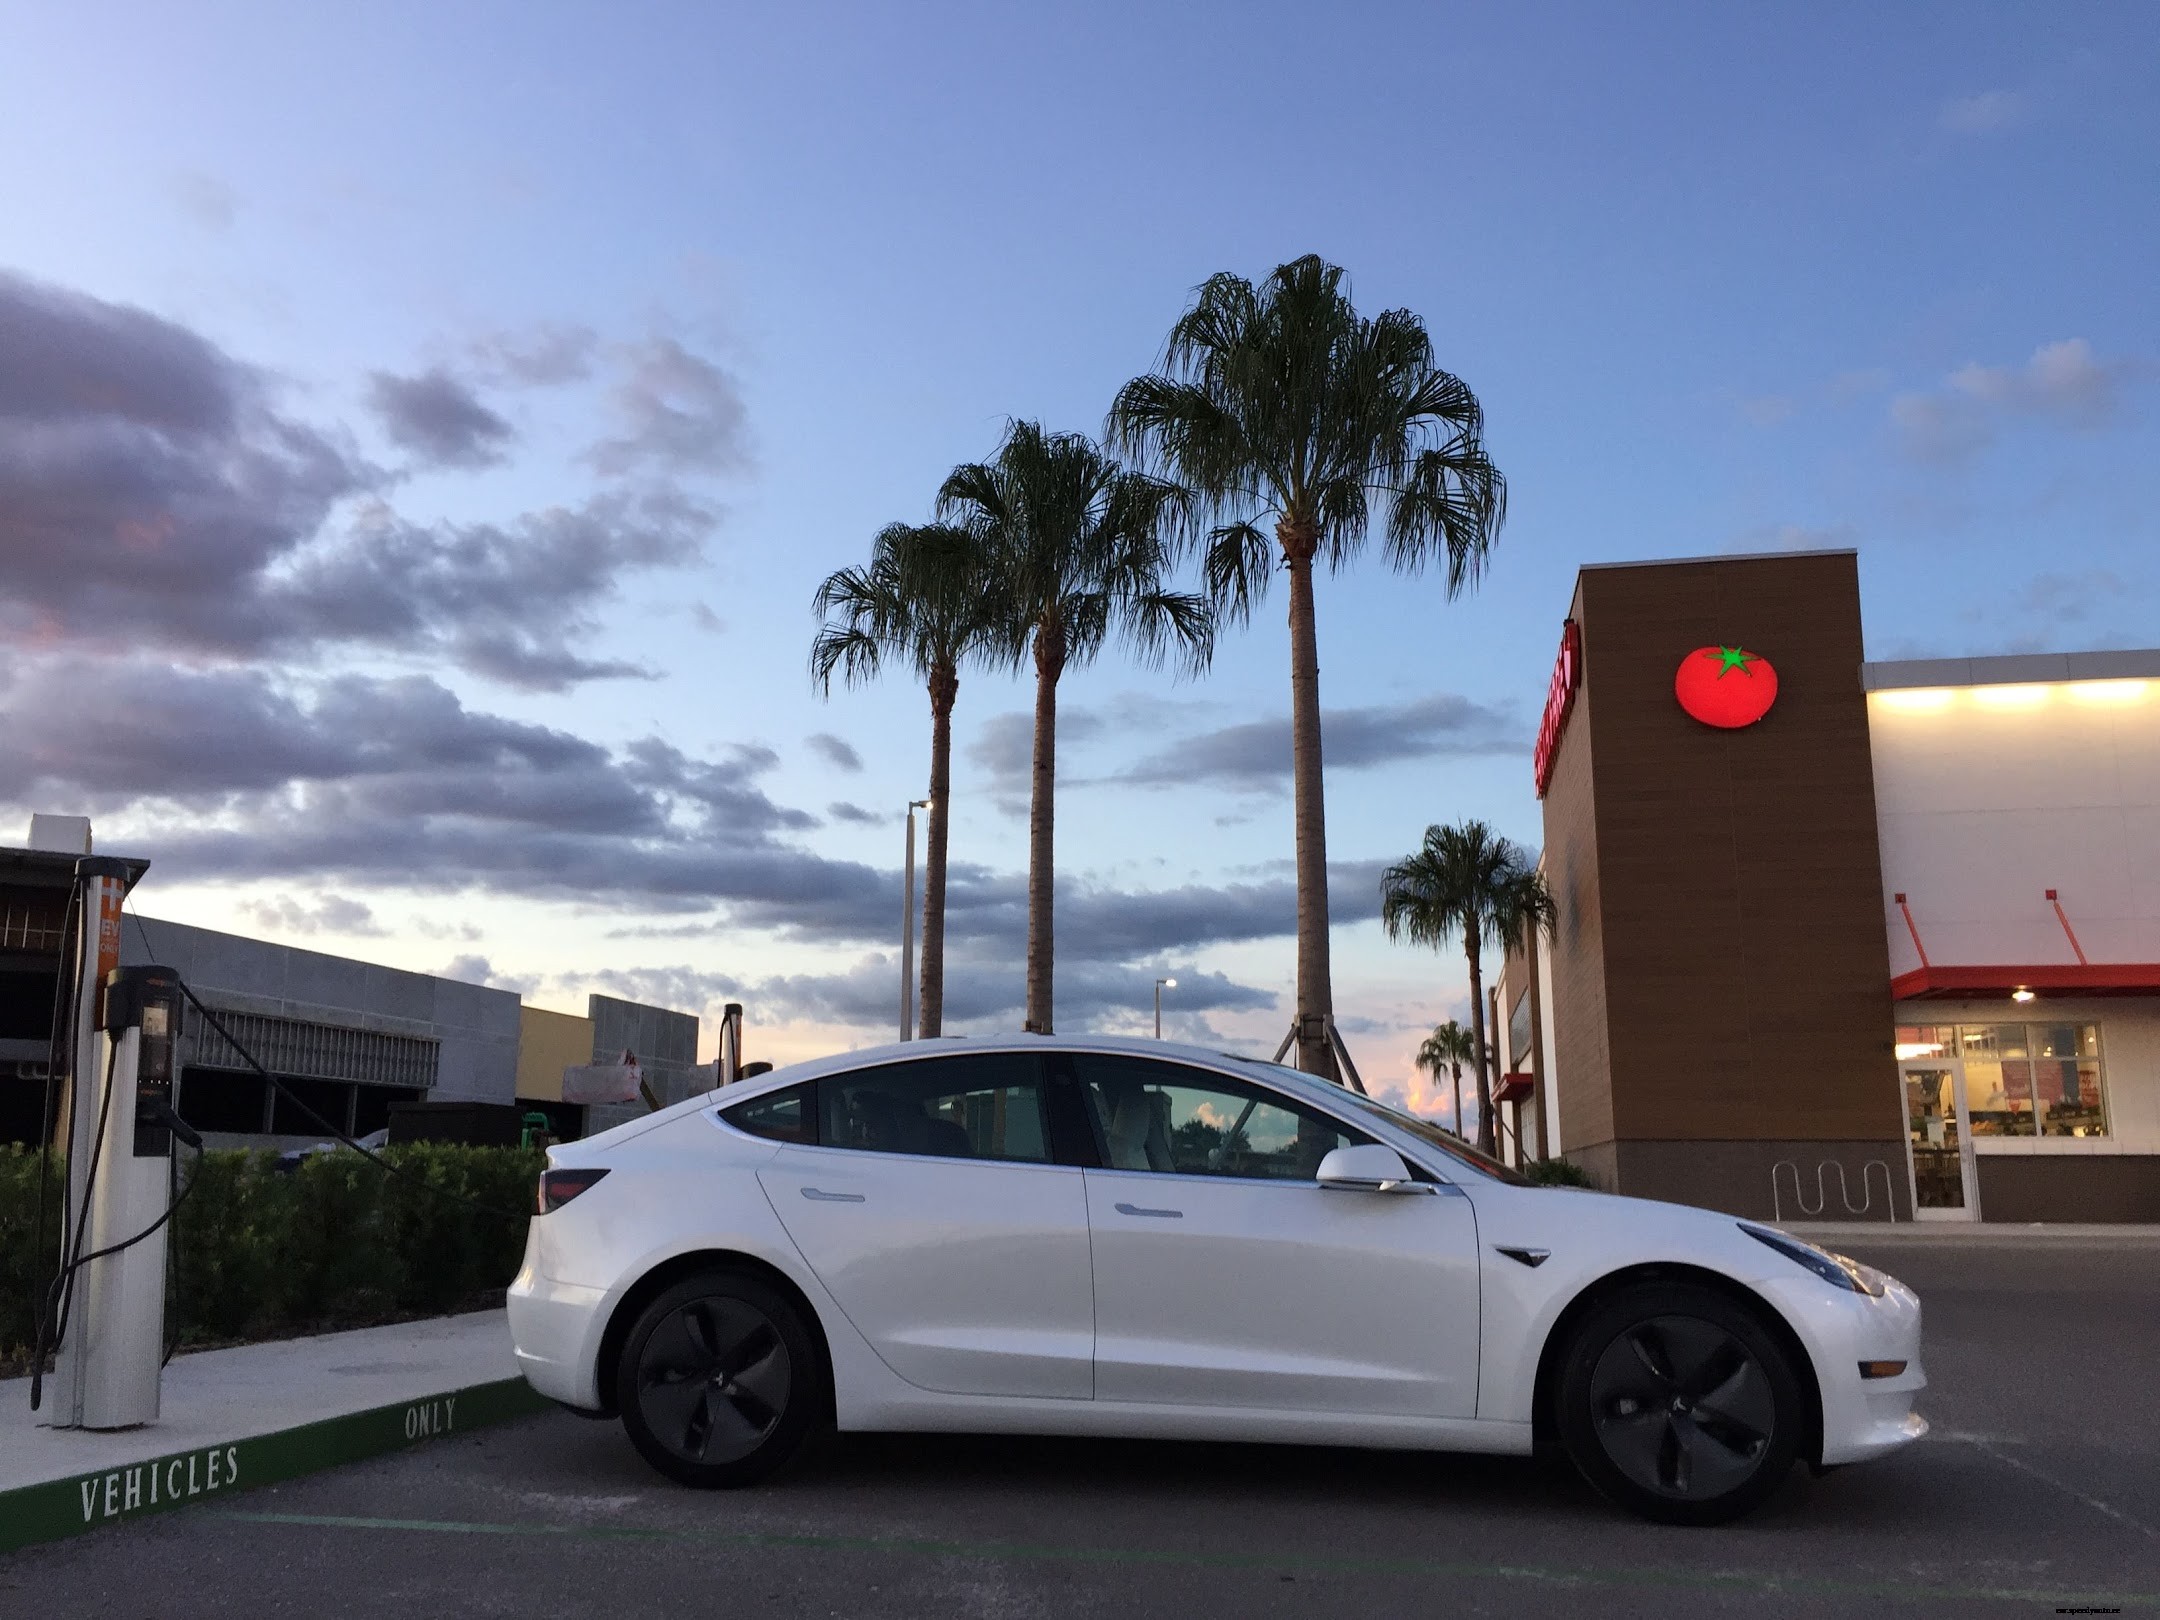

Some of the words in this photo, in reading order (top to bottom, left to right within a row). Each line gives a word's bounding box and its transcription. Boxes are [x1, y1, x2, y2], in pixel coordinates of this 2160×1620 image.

[101, 918, 120, 936] EV
[81, 1447, 238, 1522] VEHICLES
[405, 1397, 456, 1439] ONLY
